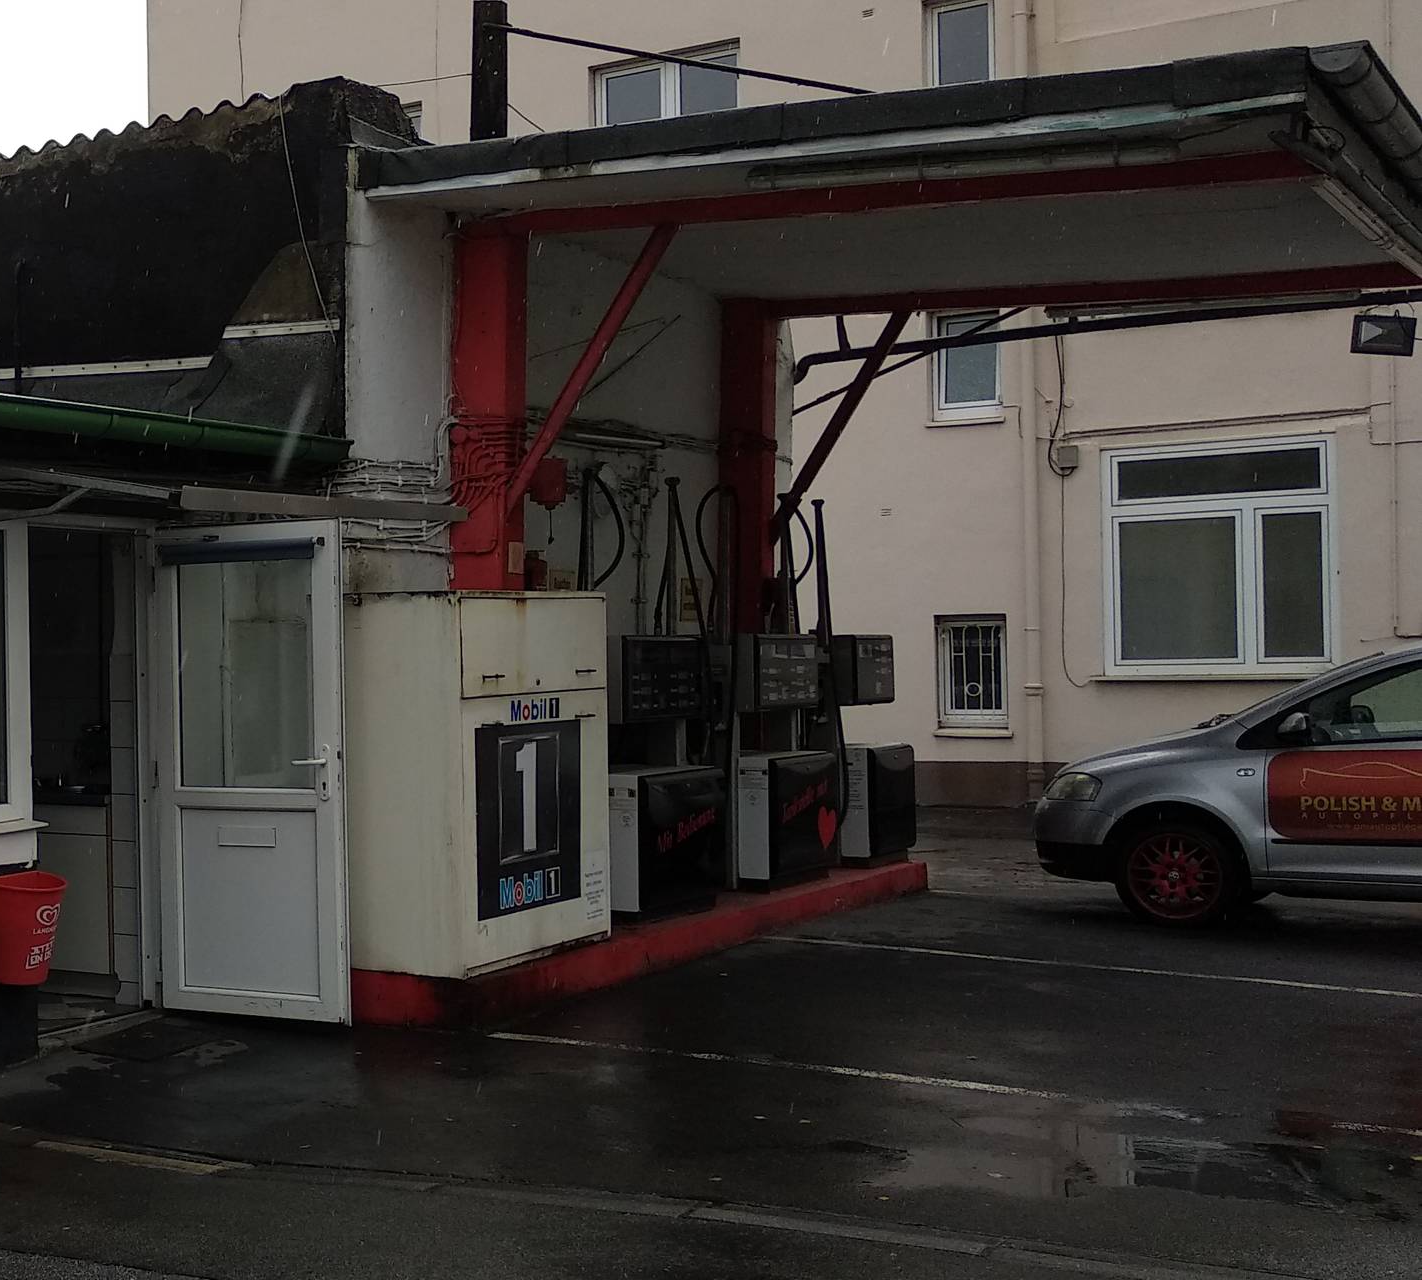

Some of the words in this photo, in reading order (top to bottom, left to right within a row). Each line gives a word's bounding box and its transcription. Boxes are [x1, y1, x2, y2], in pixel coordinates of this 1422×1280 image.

[510, 698, 547, 722] Mobil
[515, 741, 537, 852] 1
[1300, 796, 1376, 812] POLISH
[1381, 796, 1398, 812] &
[500, 870, 543, 909] Mobil
